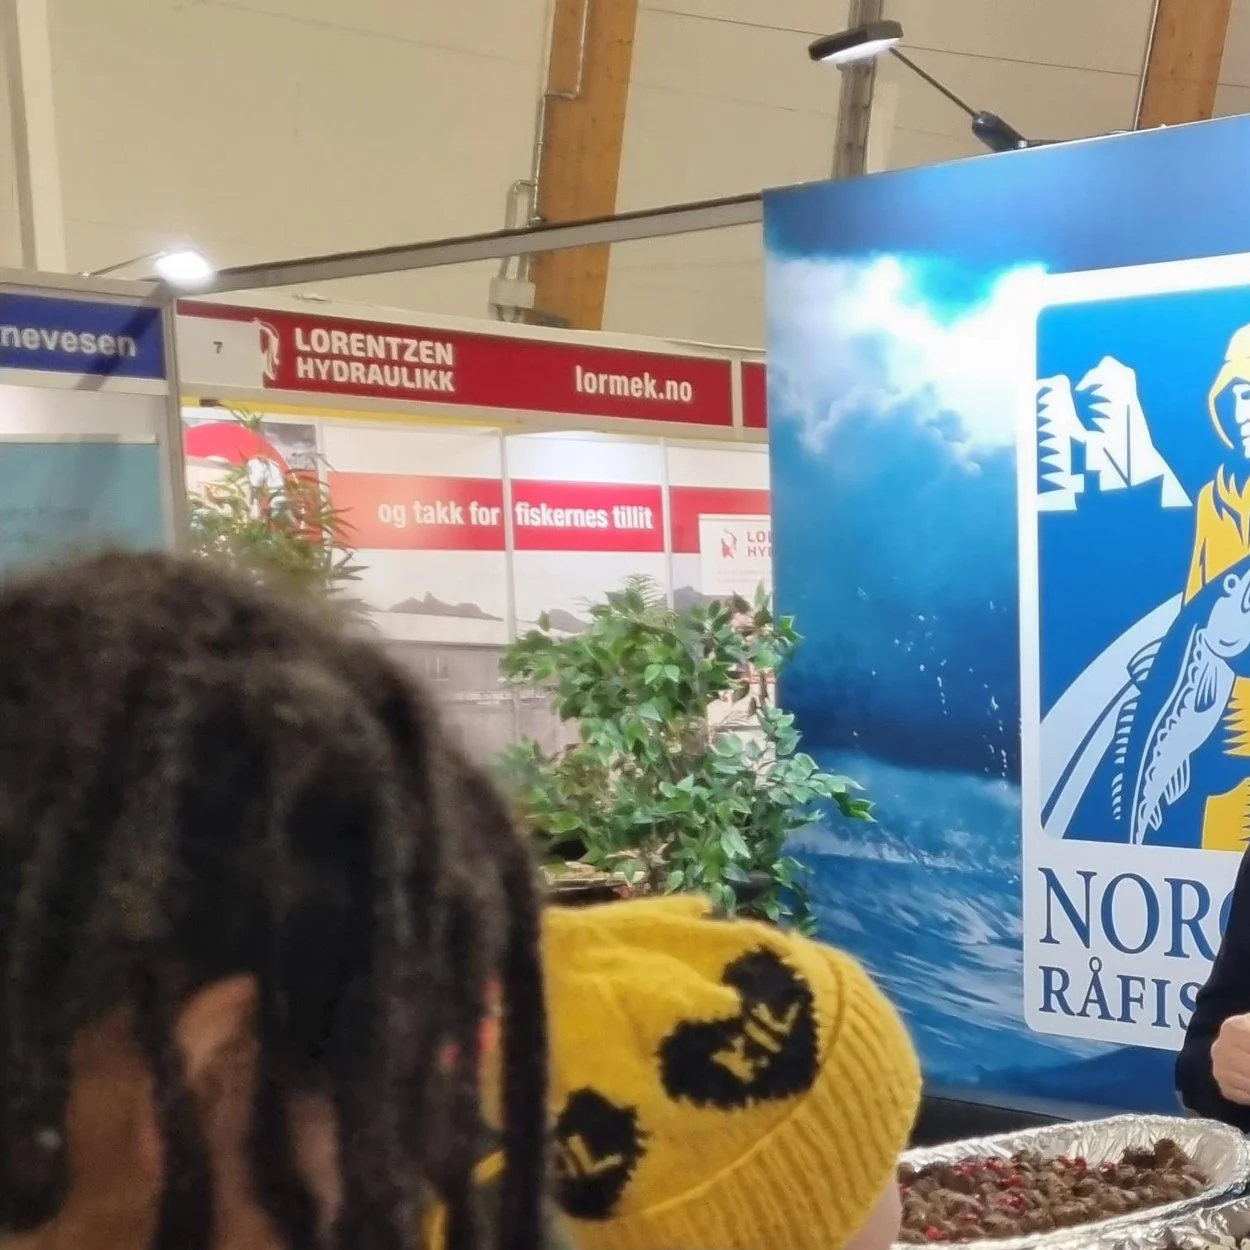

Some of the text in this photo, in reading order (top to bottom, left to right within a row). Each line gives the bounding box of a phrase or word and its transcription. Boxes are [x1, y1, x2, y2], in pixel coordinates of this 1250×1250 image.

[0, 325, 137, 357] nevesen
[212, 340, 224, 355] 7
[295, 327, 454, 366] LORENTZEN
[296, 356, 455, 392] HYDRAULIKK
[575, 365, 693, 402] lormek.no
[378, 500, 653, 530] og takk for fiskernes tillit
[747, 530, 773, 543] LO
[747, 546, 773, 558] HY
